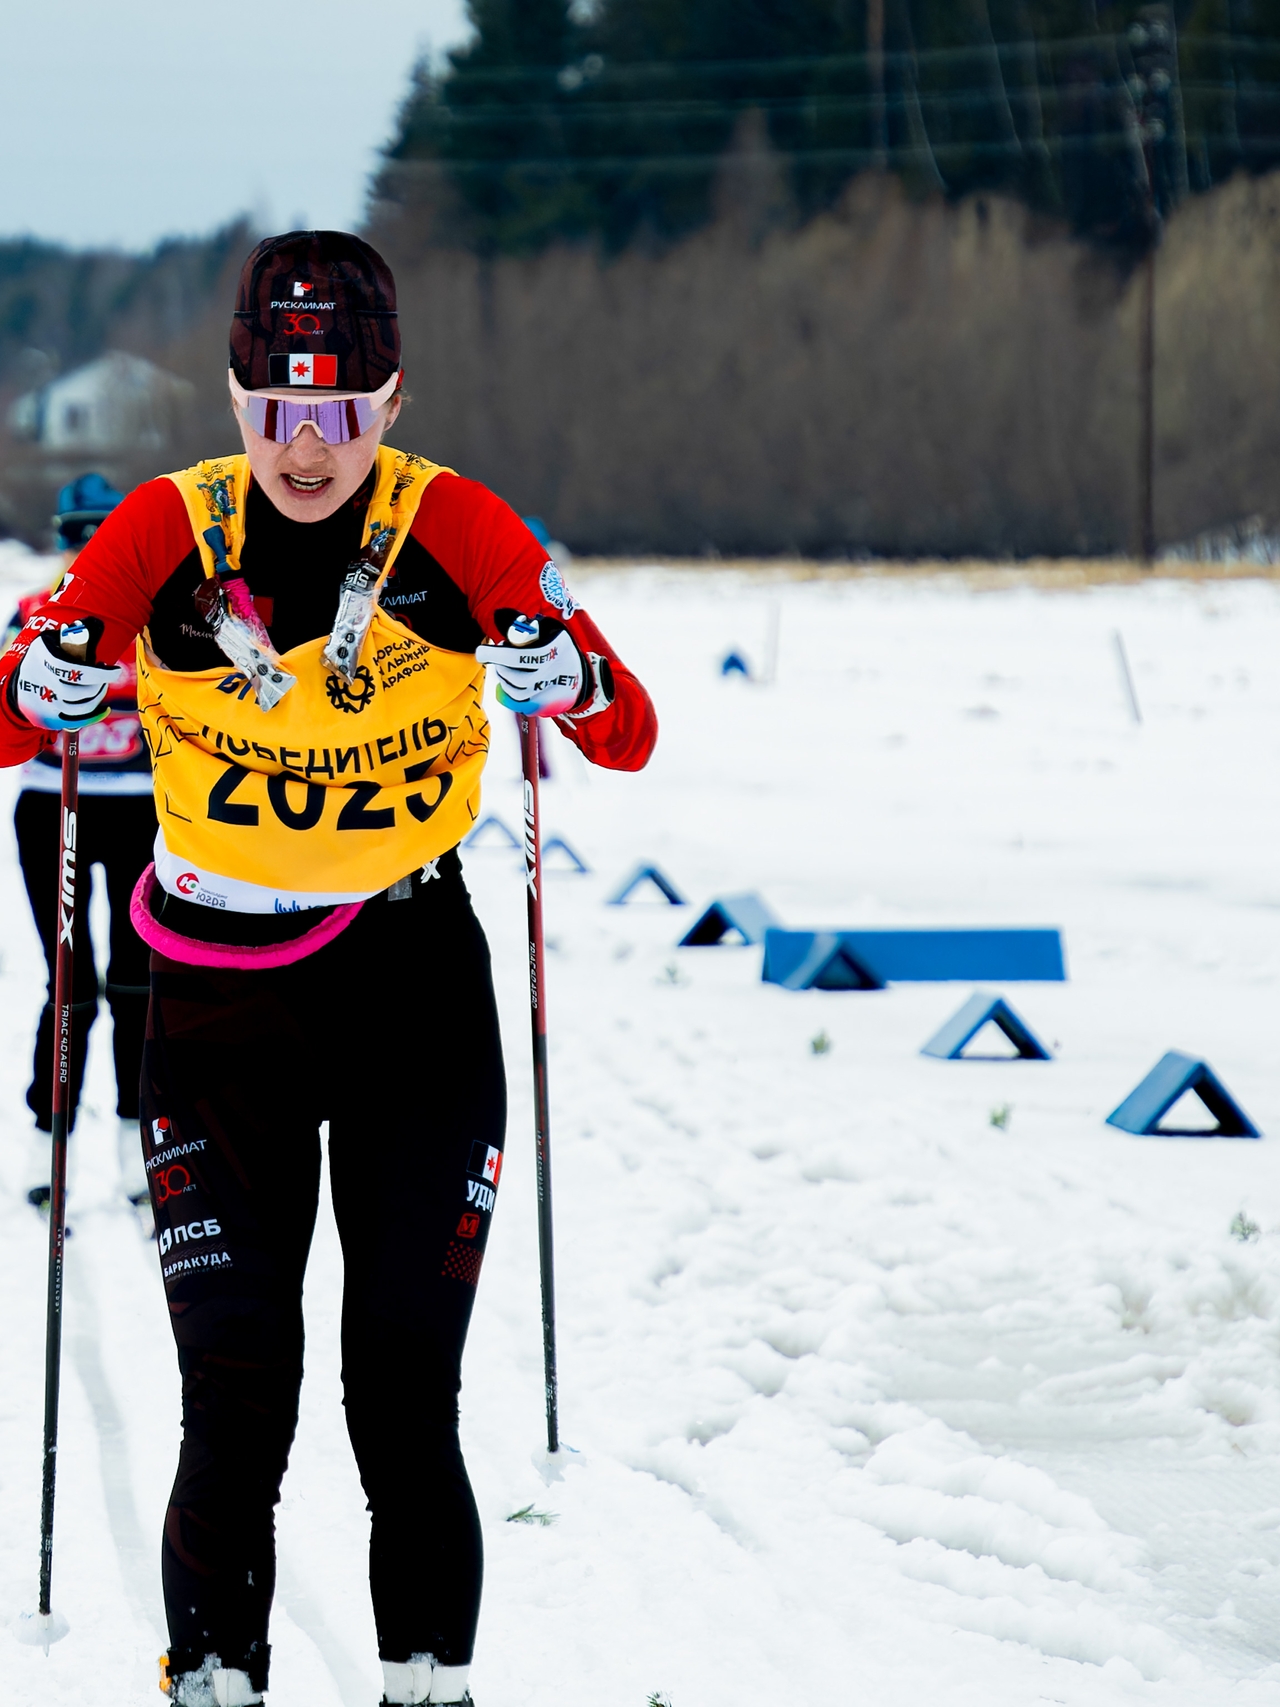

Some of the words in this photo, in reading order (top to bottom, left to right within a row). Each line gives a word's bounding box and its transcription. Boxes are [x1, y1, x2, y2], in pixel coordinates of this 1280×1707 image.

[271, 301, 336, 310] РУСКЛИМАТ
[283, 313, 320, 335] 30
[378, 591, 427, 607] ЛИМАТ
[382, 659, 429, 692] АРАФОН
[60, 806, 77, 952] SWIX
[61, 1004, 69, 1036] TRIAC
[59, 1053, 68, 1083] AERO
[155, 1164, 191, 1202] 30
[174, 1218, 221, 1244] ПСБ
[163, 1251, 232, 1278] БАРРАКУДА
